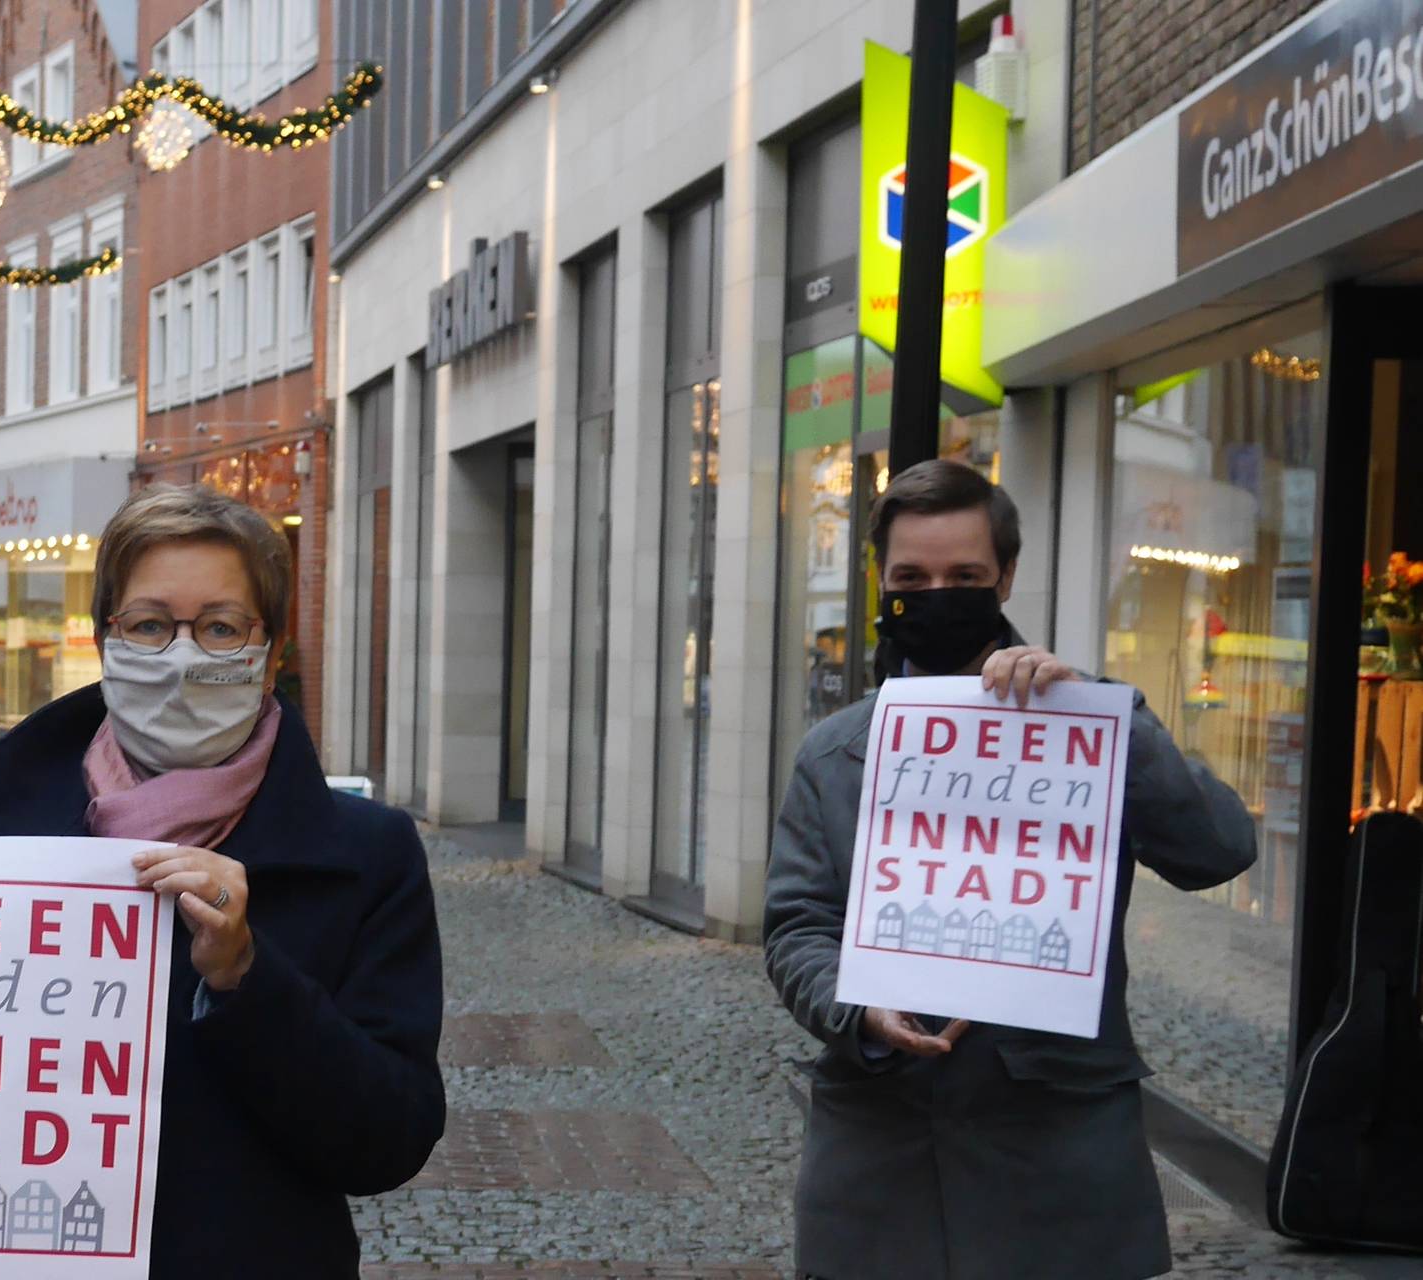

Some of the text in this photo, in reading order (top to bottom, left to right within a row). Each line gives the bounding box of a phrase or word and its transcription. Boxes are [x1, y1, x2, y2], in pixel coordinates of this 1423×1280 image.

[891, 715, 1103, 767] IDEEN
[880, 757, 1092, 808] finden
[881, 809, 1094, 863] INNEN
[875, 857, 1091, 911] STADT
